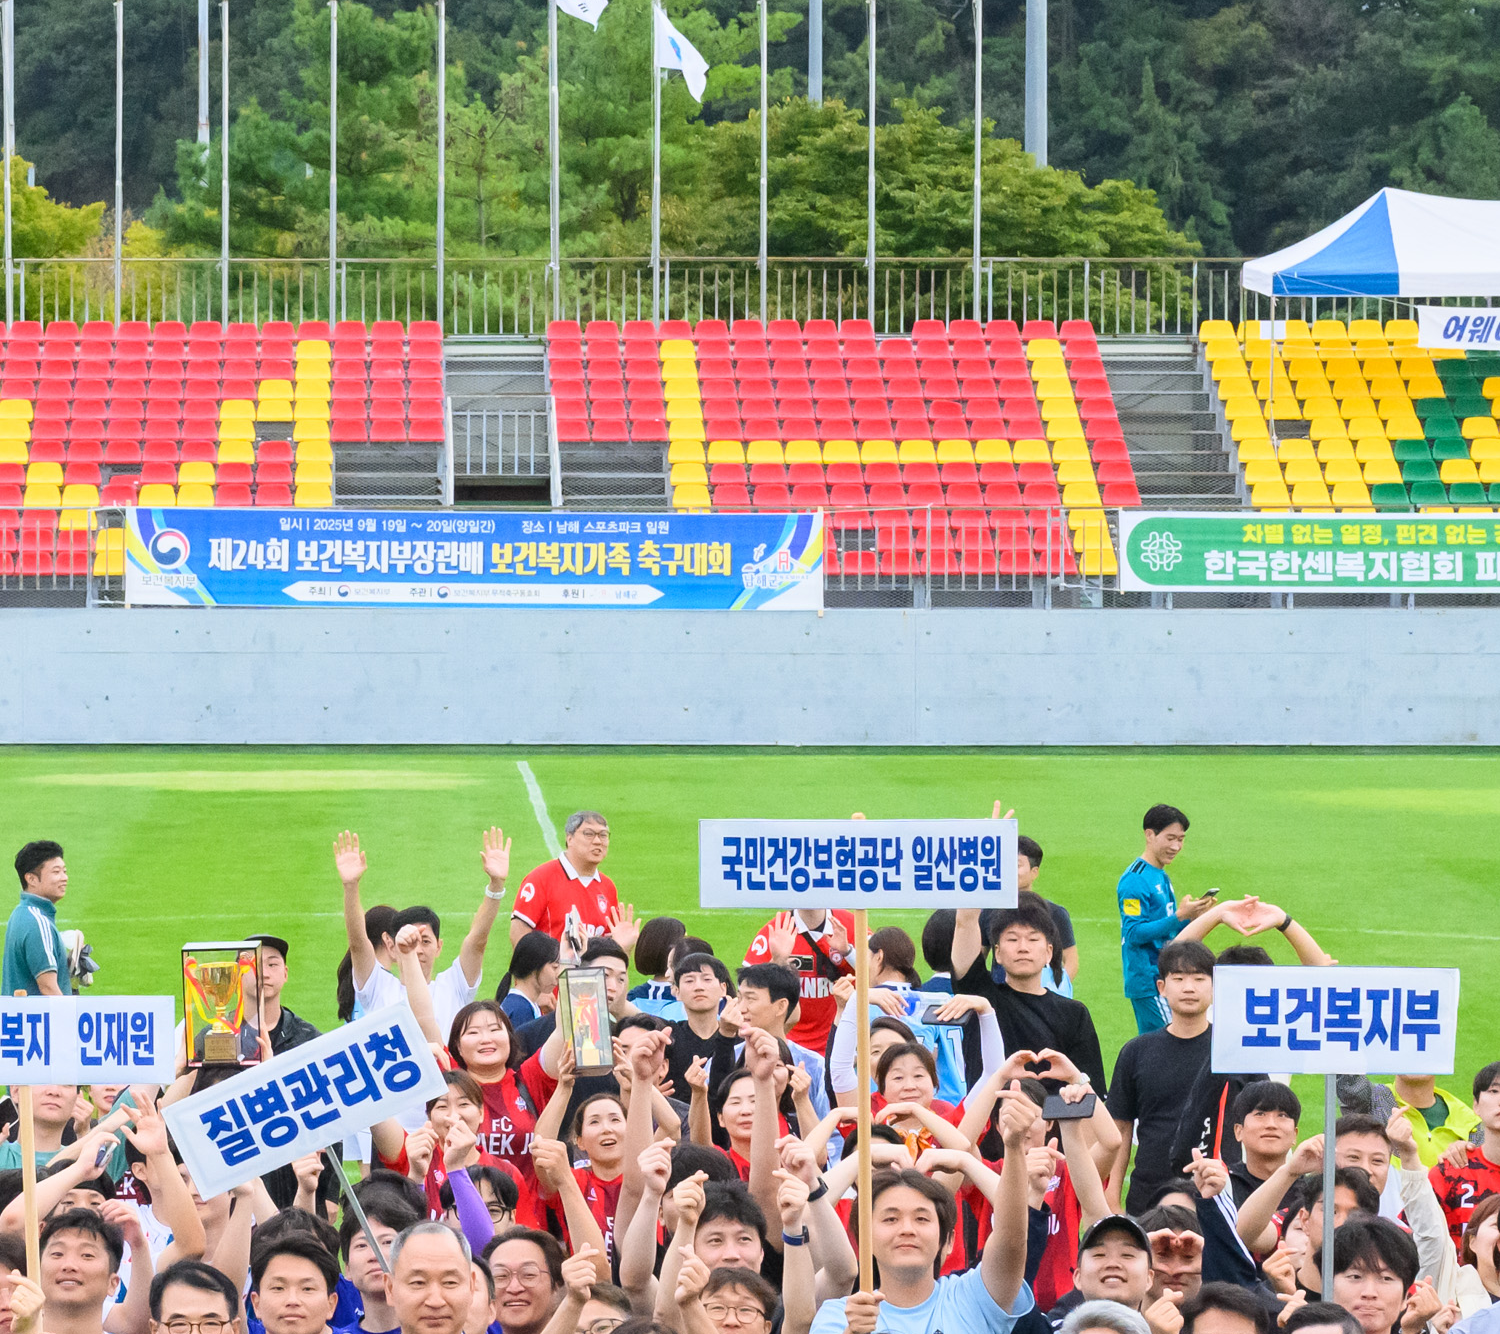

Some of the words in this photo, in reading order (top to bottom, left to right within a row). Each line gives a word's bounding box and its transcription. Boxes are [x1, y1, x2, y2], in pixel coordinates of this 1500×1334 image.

[280, 518, 302, 531] 일시
[314, 519, 352, 533] 2025년
[358, 519, 376, 534] 9월
[382, 519, 407, 534] 19일
[427, 519, 496, 534] 20일(양일간)
[522, 520, 546, 534] 장소
[556, 521, 580, 534] 남해
[583, 521, 642, 534] 스포츠파크
[646, 521, 670, 535] 일원
[1243, 524, 1284, 544] 차별
[1291, 524, 1333, 545] 없는
[1340, 524, 1389, 546] 열정,
[1396, 524, 1438, 545] 편견
[1444, 524, 1487, 545] 없는
[208, 537, 289, 572] 제24회
[296, 539, 484, 575] 보건복지부장관배
[491, 541, 630, 576] 보건복지가족
[639, 540, 732, 576] 축구대회
[1204, 550, 1463, 582] 한국한센복지협회
[142, 574, 198, 588] 보건복지부
[742, 574, 780, 589] 남해군
[721, 835, 904, 893] 국민건강보험공단
[911, 834, 1002, 893] 일산병원
[1240, 986, 1442, 1052] 보건복지부
[77, 1010, 156, 1066] 인재원
[199, 1023, 423, 1167] 질병관리청
[492, 1115, 513, 1134] FC
